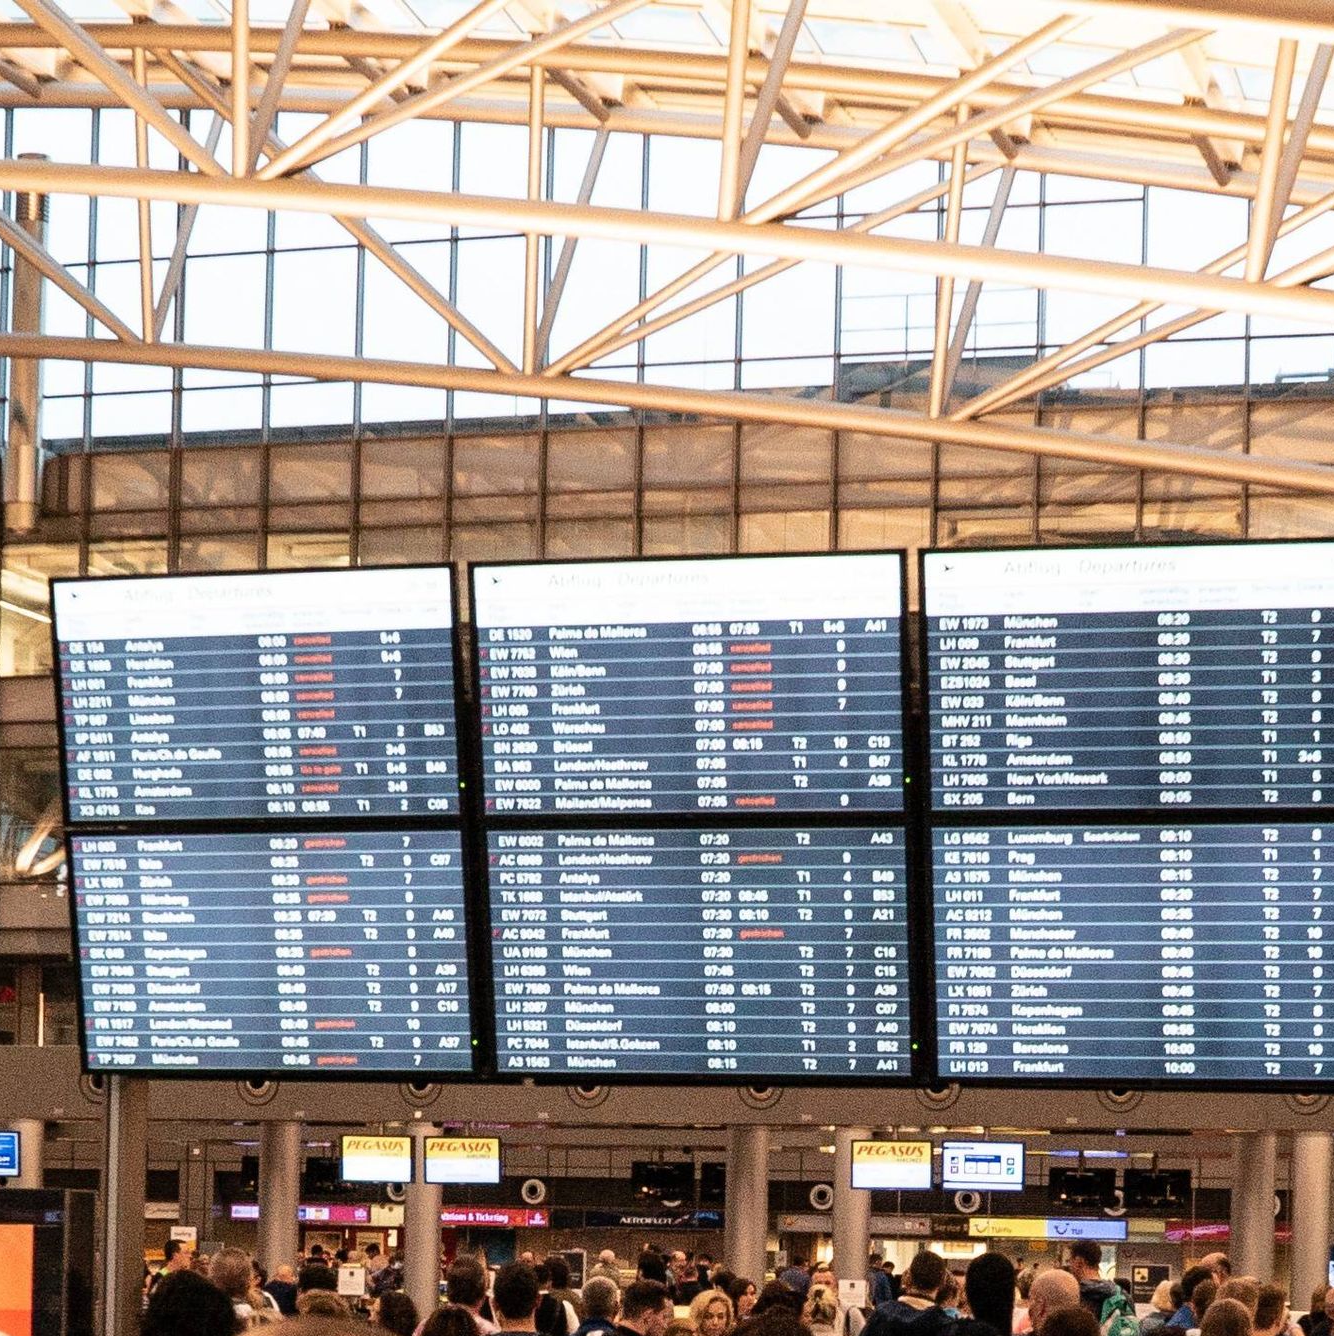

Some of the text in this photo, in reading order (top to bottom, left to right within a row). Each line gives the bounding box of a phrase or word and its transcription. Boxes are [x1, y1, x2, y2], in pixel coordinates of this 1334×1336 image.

[788, 619, 804, 634] T1
[938, 616, 960, 631] EW
[1003, 614, 1058, 629] München
[1260, 609, 1278, 624] T2
[939, 629, 1321, 651] LH Frankfurt T2 7
[1003, 653, 1056, 671] Stuttgart
[1260, 669, 1277, 684] T1
[550, 701, 601, 716] Frankfurt
[970, 714, 992, 727] 211
[352, 724, 367, 738] T1
[791, 755, 807, 769] T1
[838, 755, 848, 768] 4
[942, 749, 1277, 767] KL Amsterdam T1
[1006, 791, 1035, 805] Bern
[1261, 788, 1279, 803] T2
[356, 798, 370, 811] T1
[497, 835, 518, 847] EW
[556, 833, 592, 847] Palma
[591, 834, 607, 847] de
[607, 833, 655, 846] Mallorca
[698, 833, 730, 846] 07:20
[794, 831, 811, 845] T2
[869, 831, 894, 844] A43
[1007, 827, 1279, 846] Luxemburg T2
[795, 869, 811, 882] T1
[842, 870, 852, 882] 4
[796, 907, 894, 921] T2 A21
[844, 945, 854, 958] 7
[365, 981, 382, 994] T2
[505, 1000, 898, 1015] LH München T2 7 C07
[800, 1038, 816, 1051] T1
[566, 1055, 617, 1068] München
[801, 1057, 818, 1070] T2
[847, 1057, 857, 1070] 7
[949, 1060, 966, 1073] LH
[1012, 1059, 1065, 1073] Frankfurt
[1263, 1061, 1281, 1075] T2
[1313, 1062, 1323, 1075] 7
[346, 1139, 405, 1152] PEGASUS
[428, 1141, 493, 1153] PEGASUS
[856, 1145, 925, 1157] PEGASUS
[476, 1212, 509, 1224] Ticketing
[619, 1215, 673, 1225] AEROFLOT
[1070, 1228, 1084, 1237] TUI
